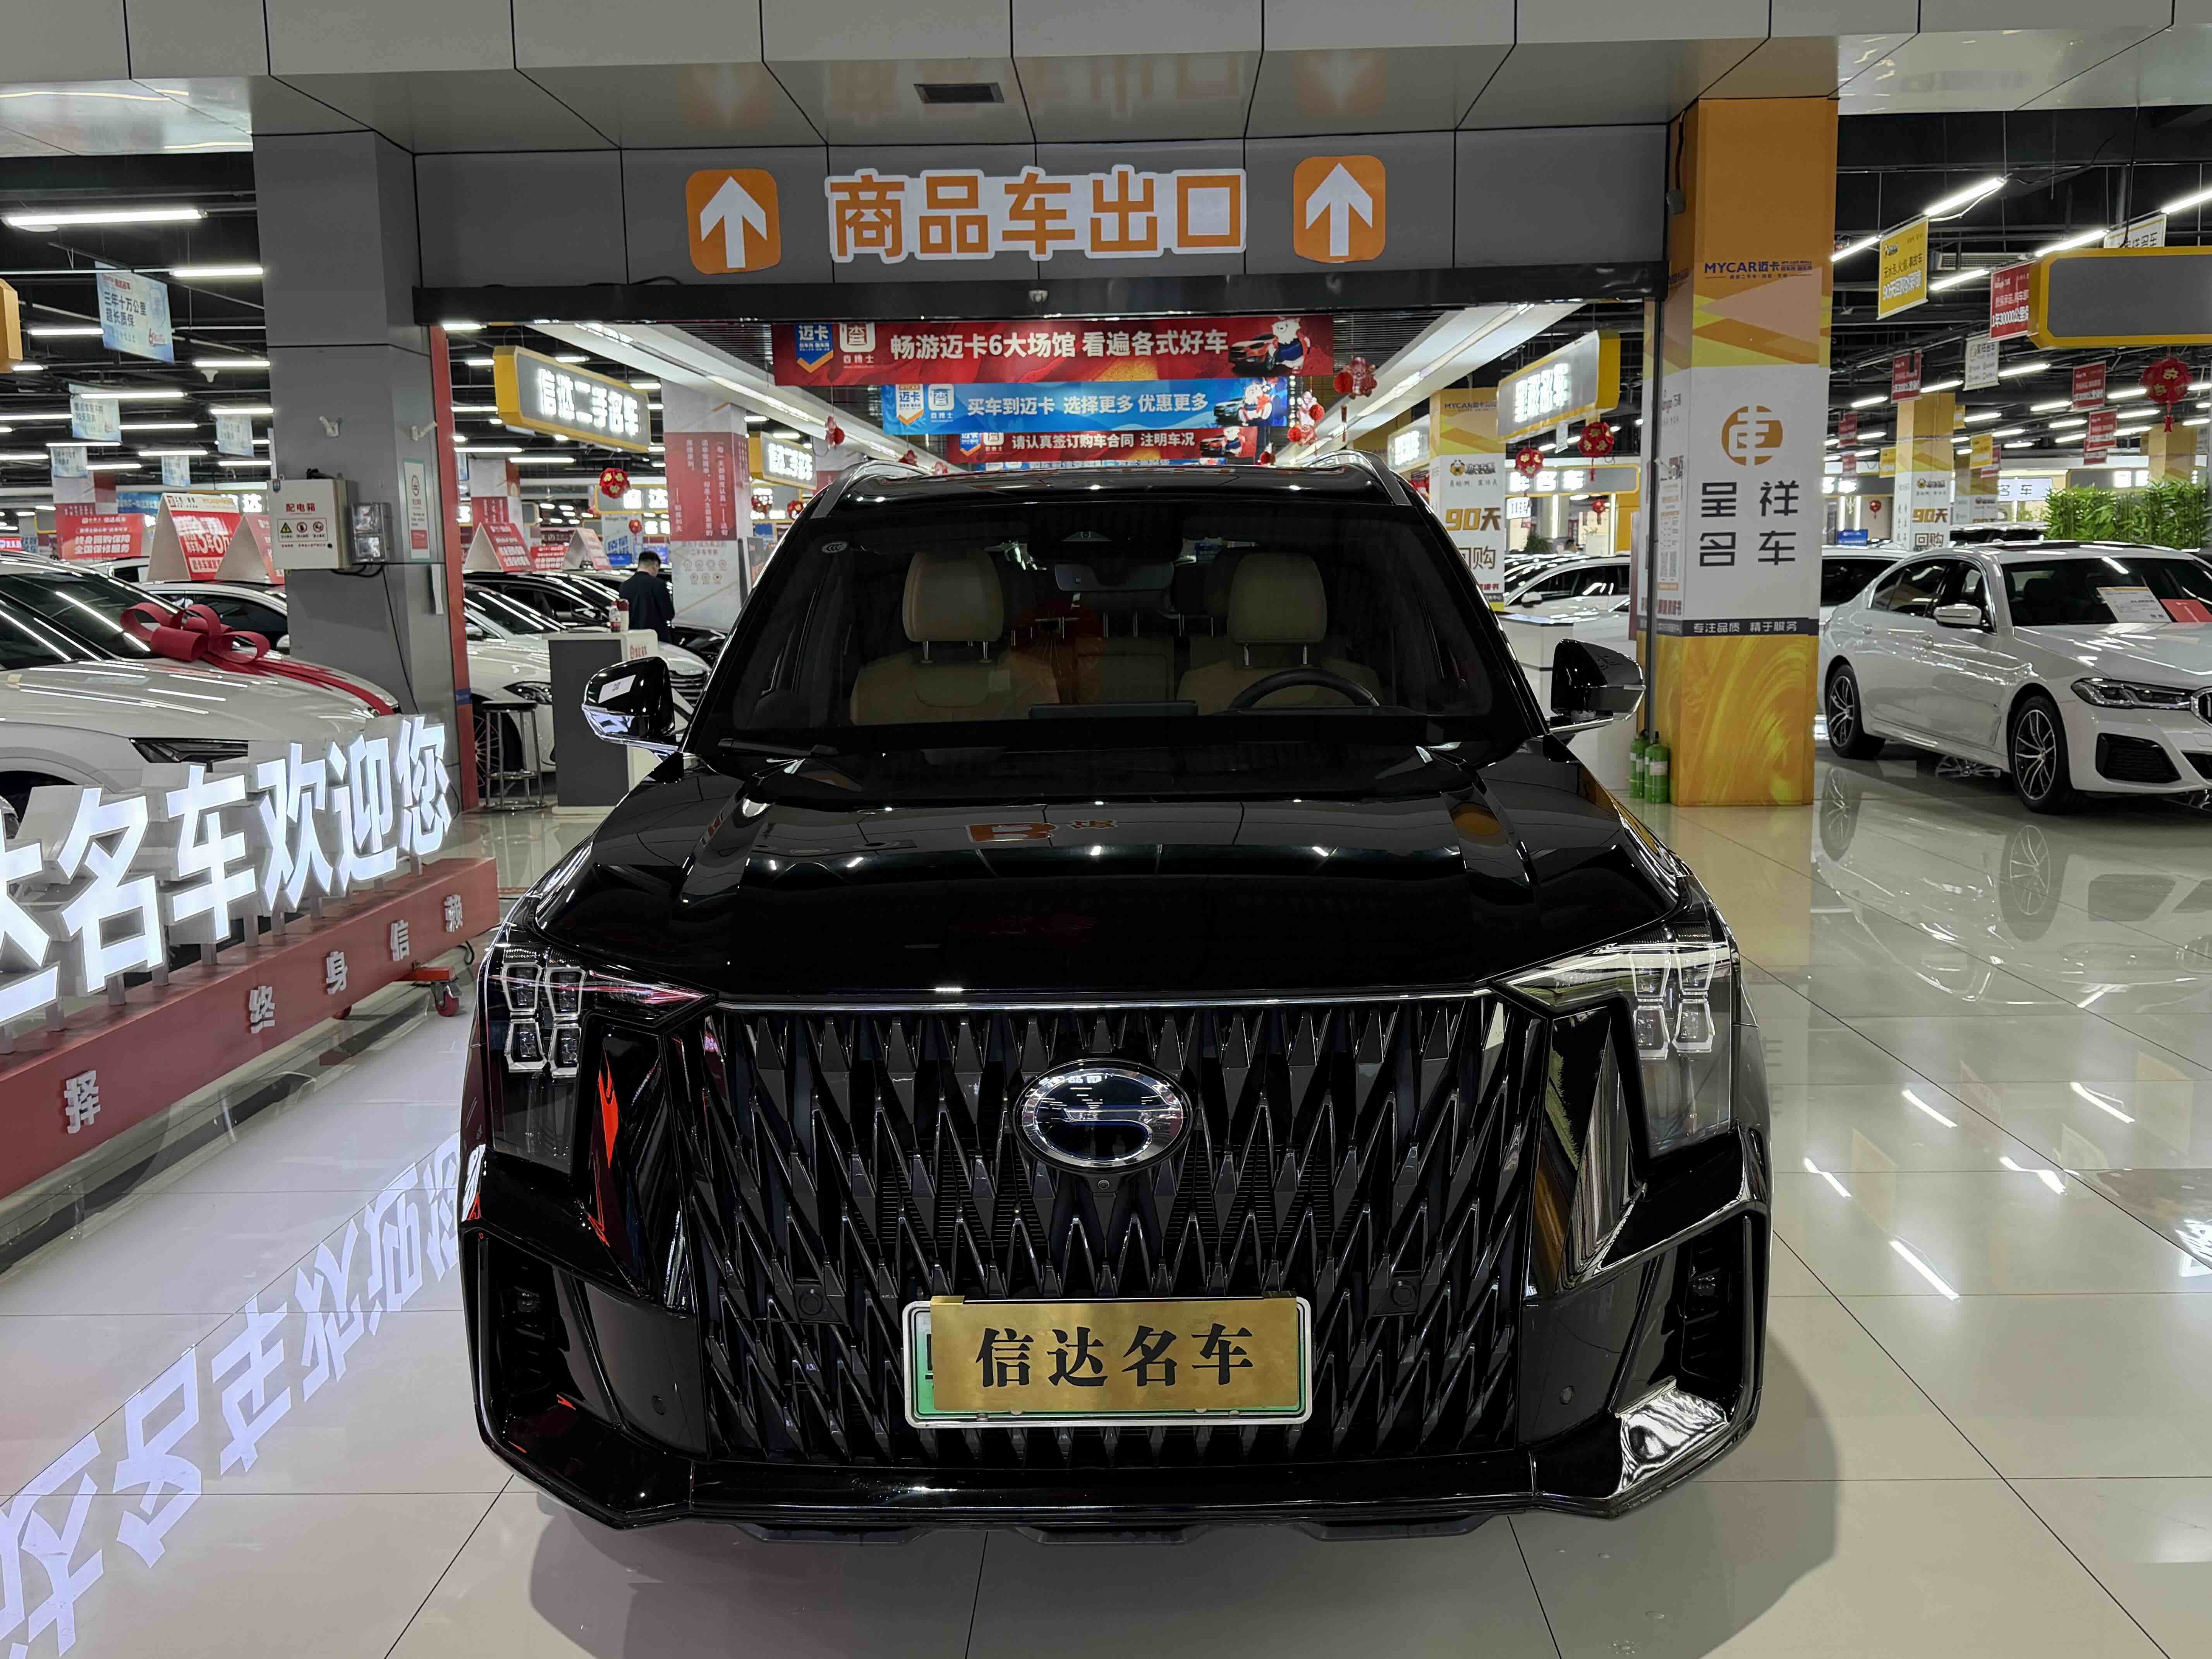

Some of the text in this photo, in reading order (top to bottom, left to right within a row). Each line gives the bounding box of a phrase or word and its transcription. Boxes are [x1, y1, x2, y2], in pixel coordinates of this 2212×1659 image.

[831, 170, 1240, 258] 商品车出口
[799, 325, 829, 341] 迈卡
[891, 329, 1228, 360] 畅游迈卡6大场馆 看遍各式好车
[538, 367, 640, 437] 信达二手名车
[899, 391, 921, 402] 迈卡
[967, 392, 1208, 416] 买车到迈卡 选择更多 优惠更多
[1012, 432, 1195, 449] 请认真签订购车合同 注明车况
[286, 503, 315, 512] 配电箱
[1912, 508, 1948, 523] 90天
[1446, 507, 1501, 531] 90天
[1699, 531, 1796, 567] 名车
[1915, 532, 1944, 548] 回购
[1693, 623, 1740, 633] 专注品质
[975, 1323, 1254, 1388] 信达名车
